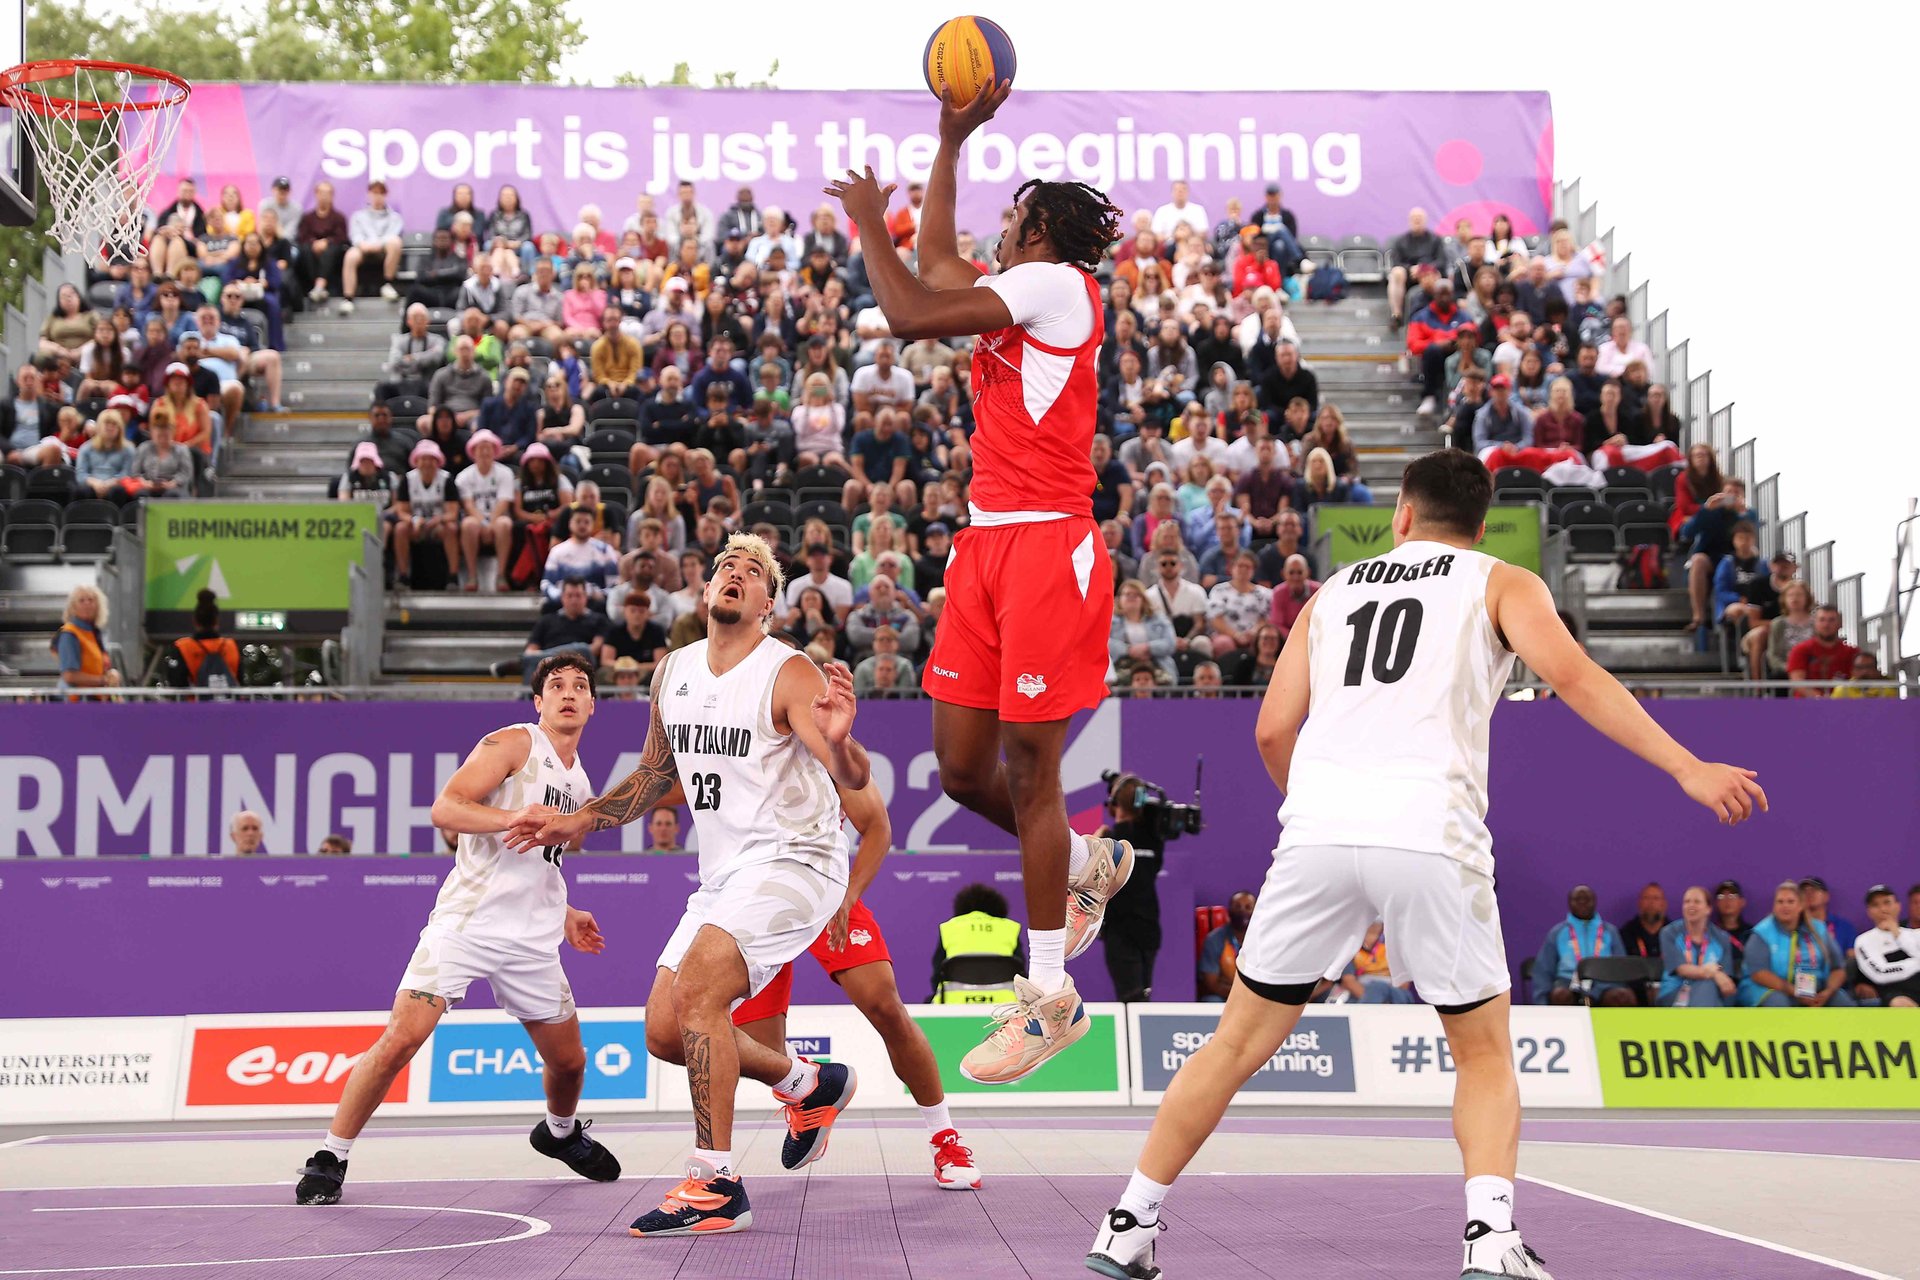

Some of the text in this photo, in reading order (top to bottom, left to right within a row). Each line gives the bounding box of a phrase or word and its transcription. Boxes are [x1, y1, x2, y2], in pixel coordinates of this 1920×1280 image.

[937, 42, 945, 60] 2022
[320, 115, 1362, 196] sport is just the beginning
[167, 518, 355, 540] BIRMINGHAM 2022
[1347, 554, 1455, 585] RODGER
[1343, 597, 1424, 686] 10
[694, 724, 752, 757] ZEALAND
[691, 772, 722, 811] 23
[2, 1053, 152, 1068] UNIVERSITY OF
[1619, 1040, 1918, 1079] BIRMINGHAM
[0, 1070, 149, 1086] BIRMINGHAM
